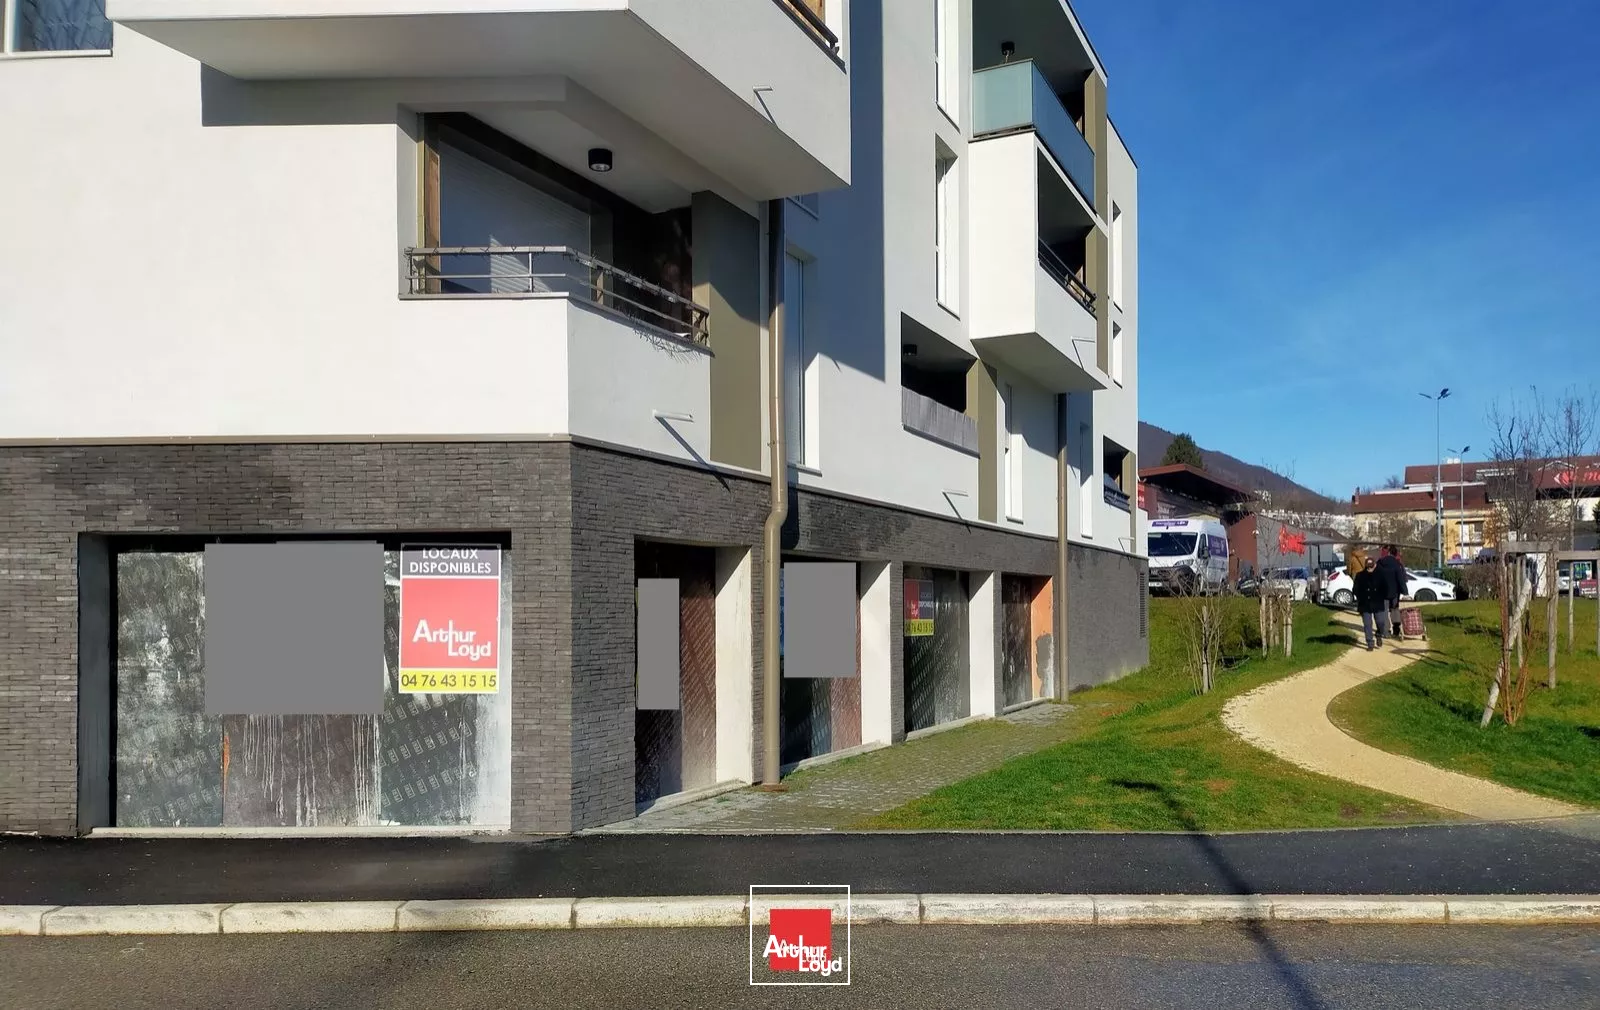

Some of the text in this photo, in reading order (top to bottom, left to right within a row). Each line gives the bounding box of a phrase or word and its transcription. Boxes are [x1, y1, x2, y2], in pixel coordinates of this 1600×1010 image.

[422, 547, 478, 559] LOCAUX
[409, 562, 492, 573] DISPONIBLES
[412, 619, 476, 642] Arthur
[448, 641, 491, 661] Loyd
[401, 675, 496, 687] 04 76 43 15 15
